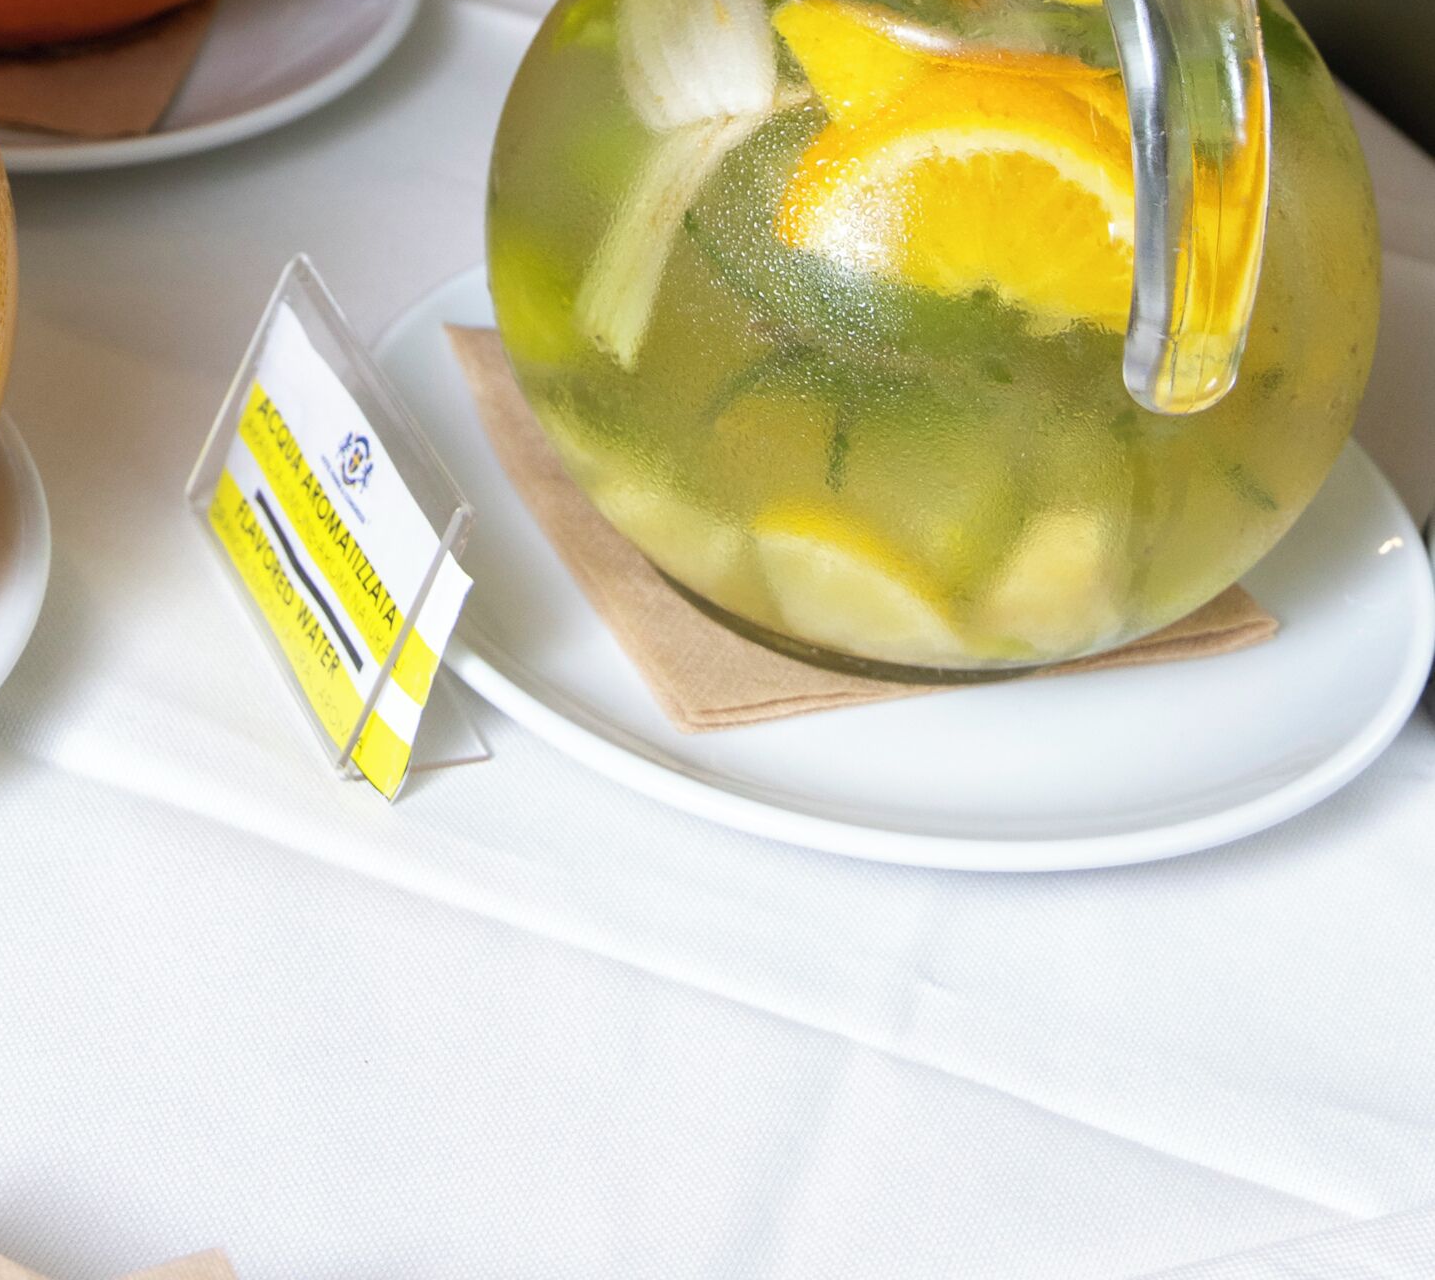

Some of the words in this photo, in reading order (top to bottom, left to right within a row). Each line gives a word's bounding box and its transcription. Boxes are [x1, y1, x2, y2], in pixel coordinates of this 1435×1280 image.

[235, 497, 294, 606] FLAVORED
[297, 598, 341, 680] WATER
[257, 396, 303, 476] ACQUA
[300, 470, 398, 632] AROMATIZZATA
